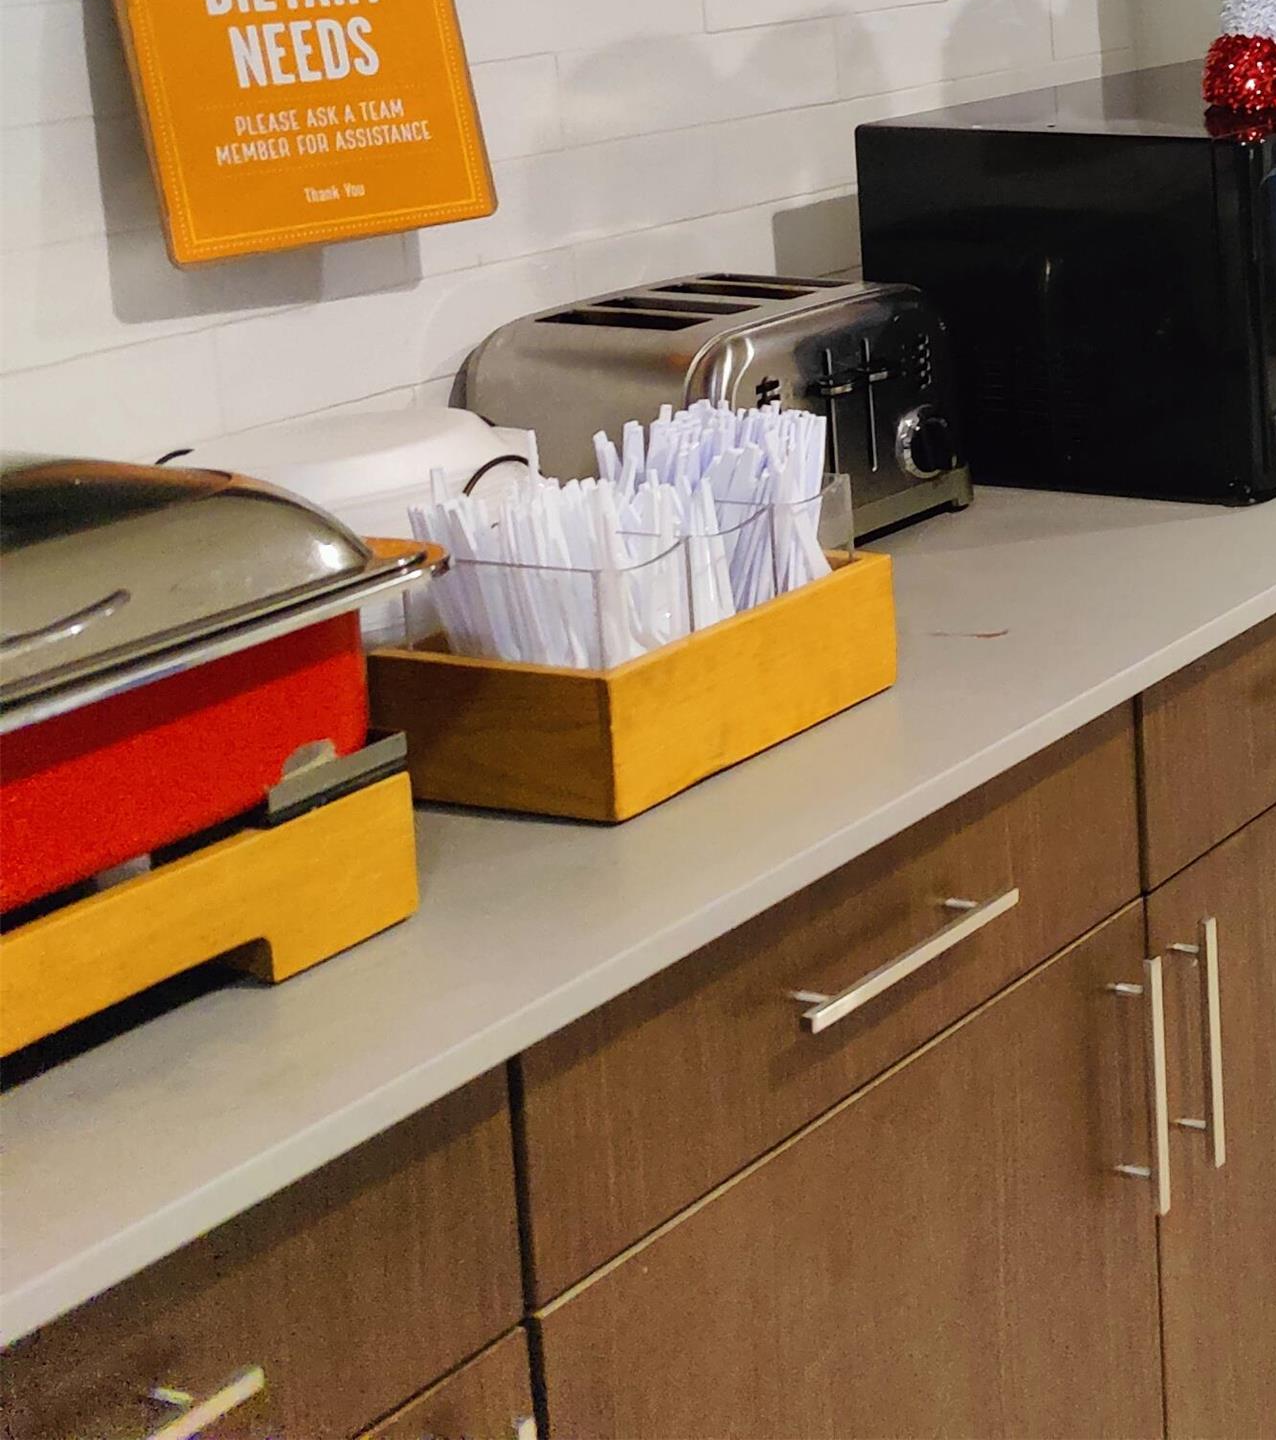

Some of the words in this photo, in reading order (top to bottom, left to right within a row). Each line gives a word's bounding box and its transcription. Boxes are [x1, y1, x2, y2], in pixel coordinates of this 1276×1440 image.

[228, 16, 380, 88] NEEDS
[234, 109, 300, 136] PLEASE
[306, 106, 339, 127] ASK
[344, 104, 356, 123] A
[359, 98, 405, 122] TEAM
[215, 138, 291, 166] MEMBER
[296, 133, 329, 156] FOR
[335, 120, 432, 151] ASSISTANCE
[304, 185, 340, 203] Thank
[343, 182, 366, 198] You
